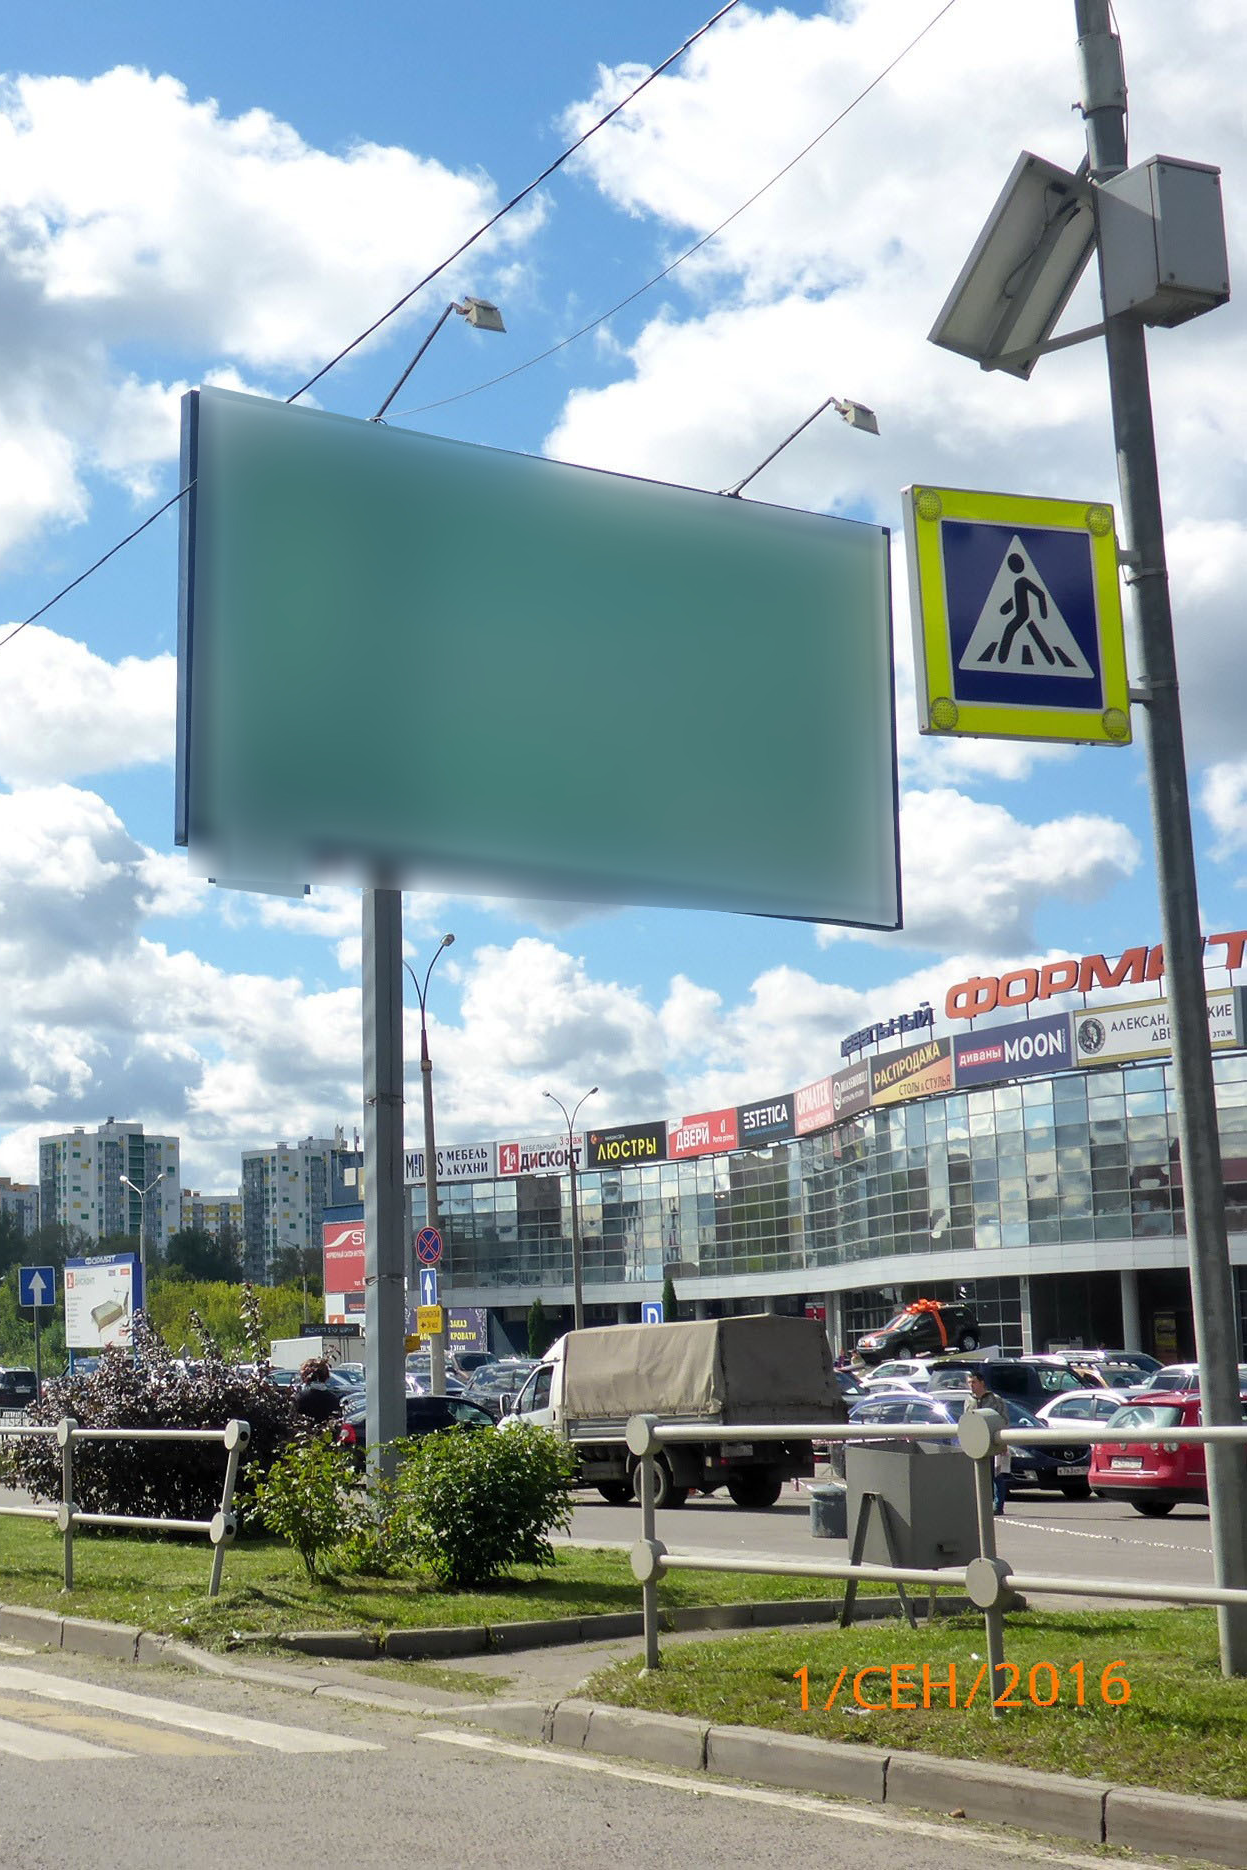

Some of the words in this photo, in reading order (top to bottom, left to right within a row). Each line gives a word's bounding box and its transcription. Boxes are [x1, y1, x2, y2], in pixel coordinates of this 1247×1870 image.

[959, 1047, 1002, 1067] диваны
[1004, 1028, 1063, 1063] MOON
[874, 1041, 941, 1088] РАСПРОДАЖА
[899, 1082, 920, 1096] СТОЛЫ
[925, 1074, 951, 1090] СТУЛЬЯ
[743, 1103, 788, 1129] ESTETICA
[597, 1137, 657, 1161] ЛЮСТРЫ
[675, 1126, 710, 1153] ДВЕРИ
[446, 1148, 488, 1162] МЕБЕЛЬ
[453, 1162, 488, 1175] КУХНИ
[450, 1331, 476, 1340] КРОВАТИ
